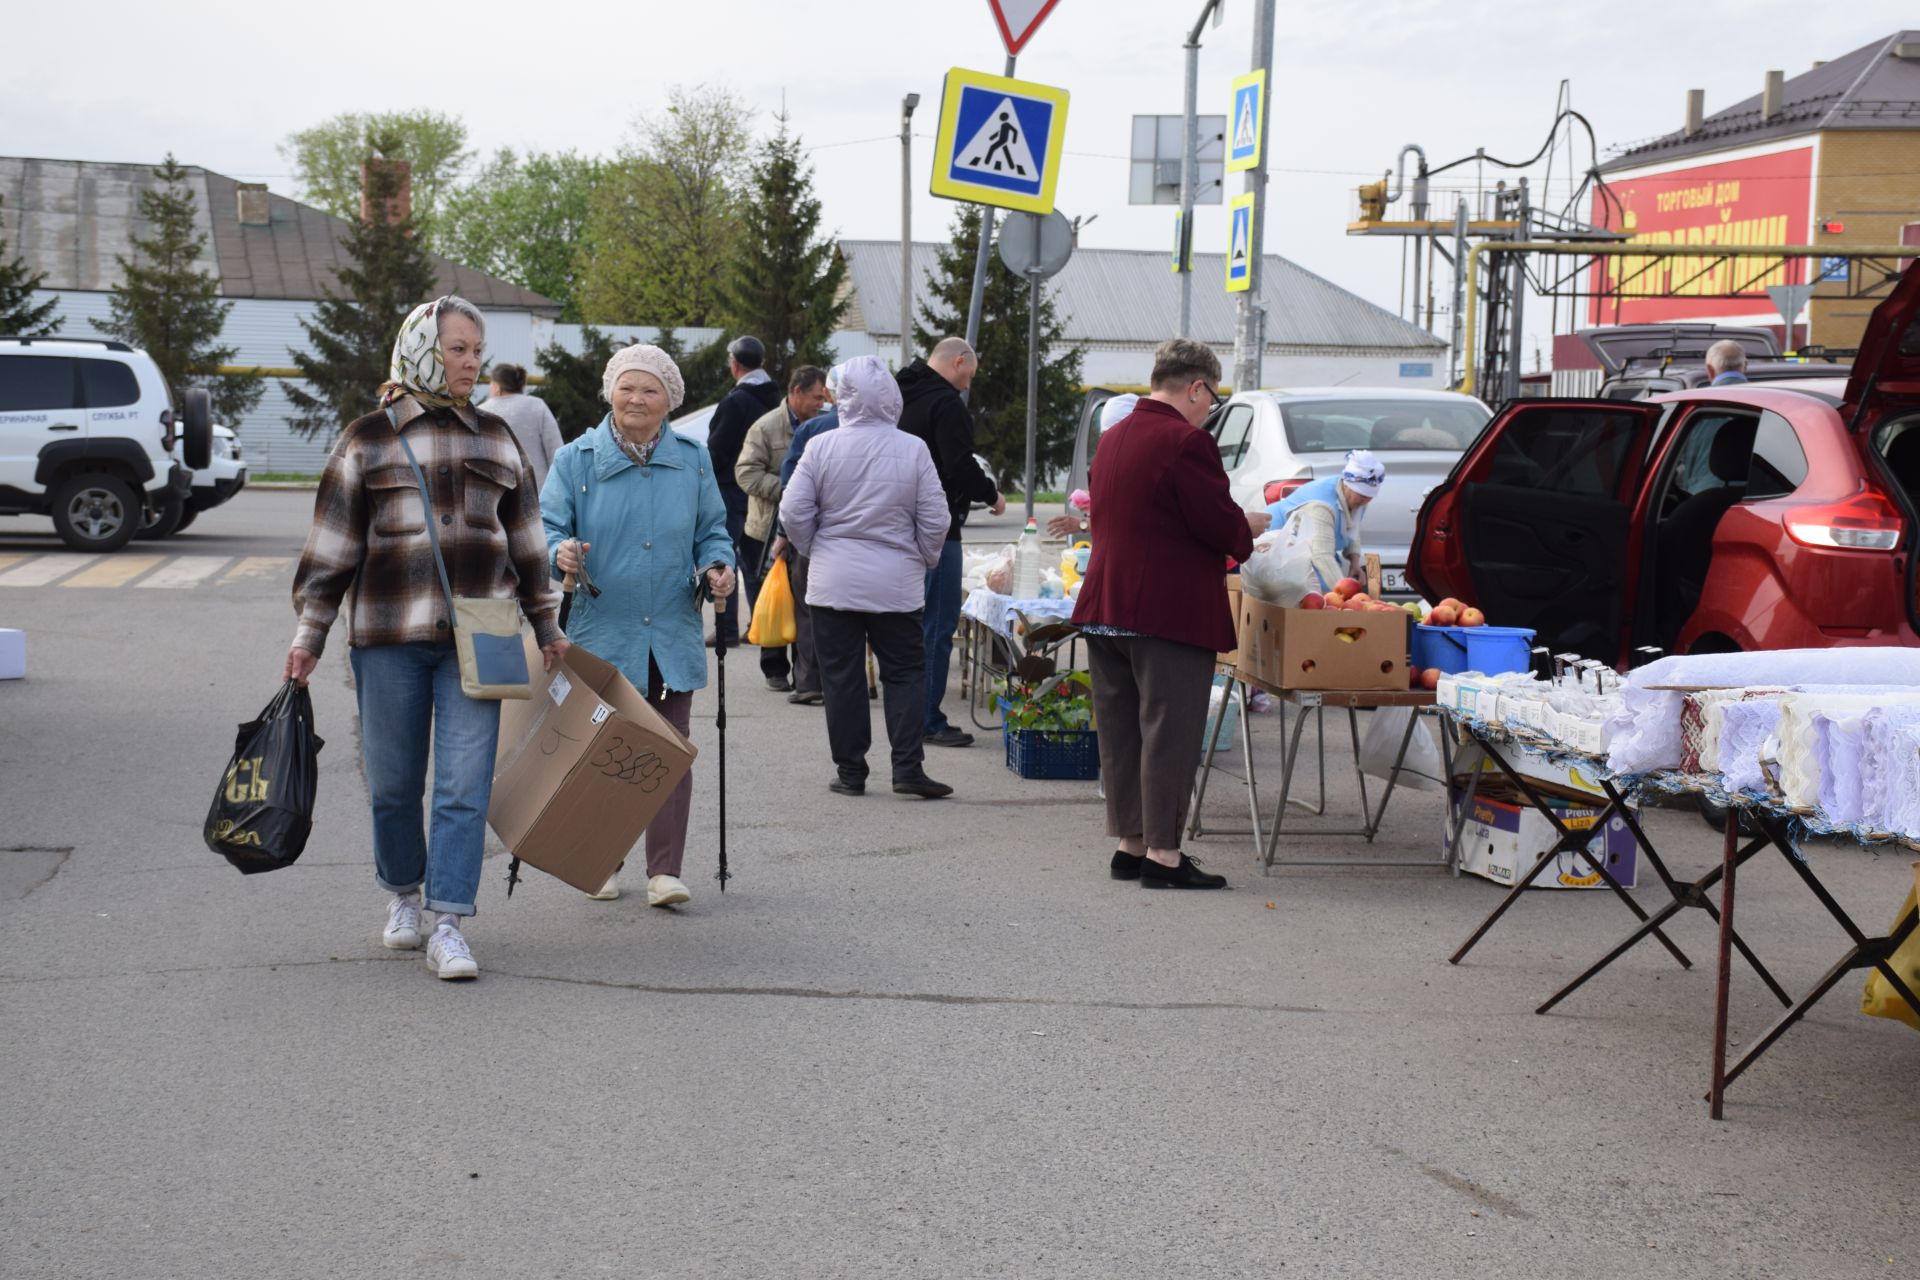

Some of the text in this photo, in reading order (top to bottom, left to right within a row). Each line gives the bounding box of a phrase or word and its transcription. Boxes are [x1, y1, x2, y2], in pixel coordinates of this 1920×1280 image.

[1656, 180, 1741, 212] ТОРГОВЫЙ ДОМ
[92, 411, 125, 421] СЛУЖБА
[591, 736, 669, 793] 33893
[1565, 808, 1595, 818] Pretty
[1570, 819, 1592, 829] Liza
